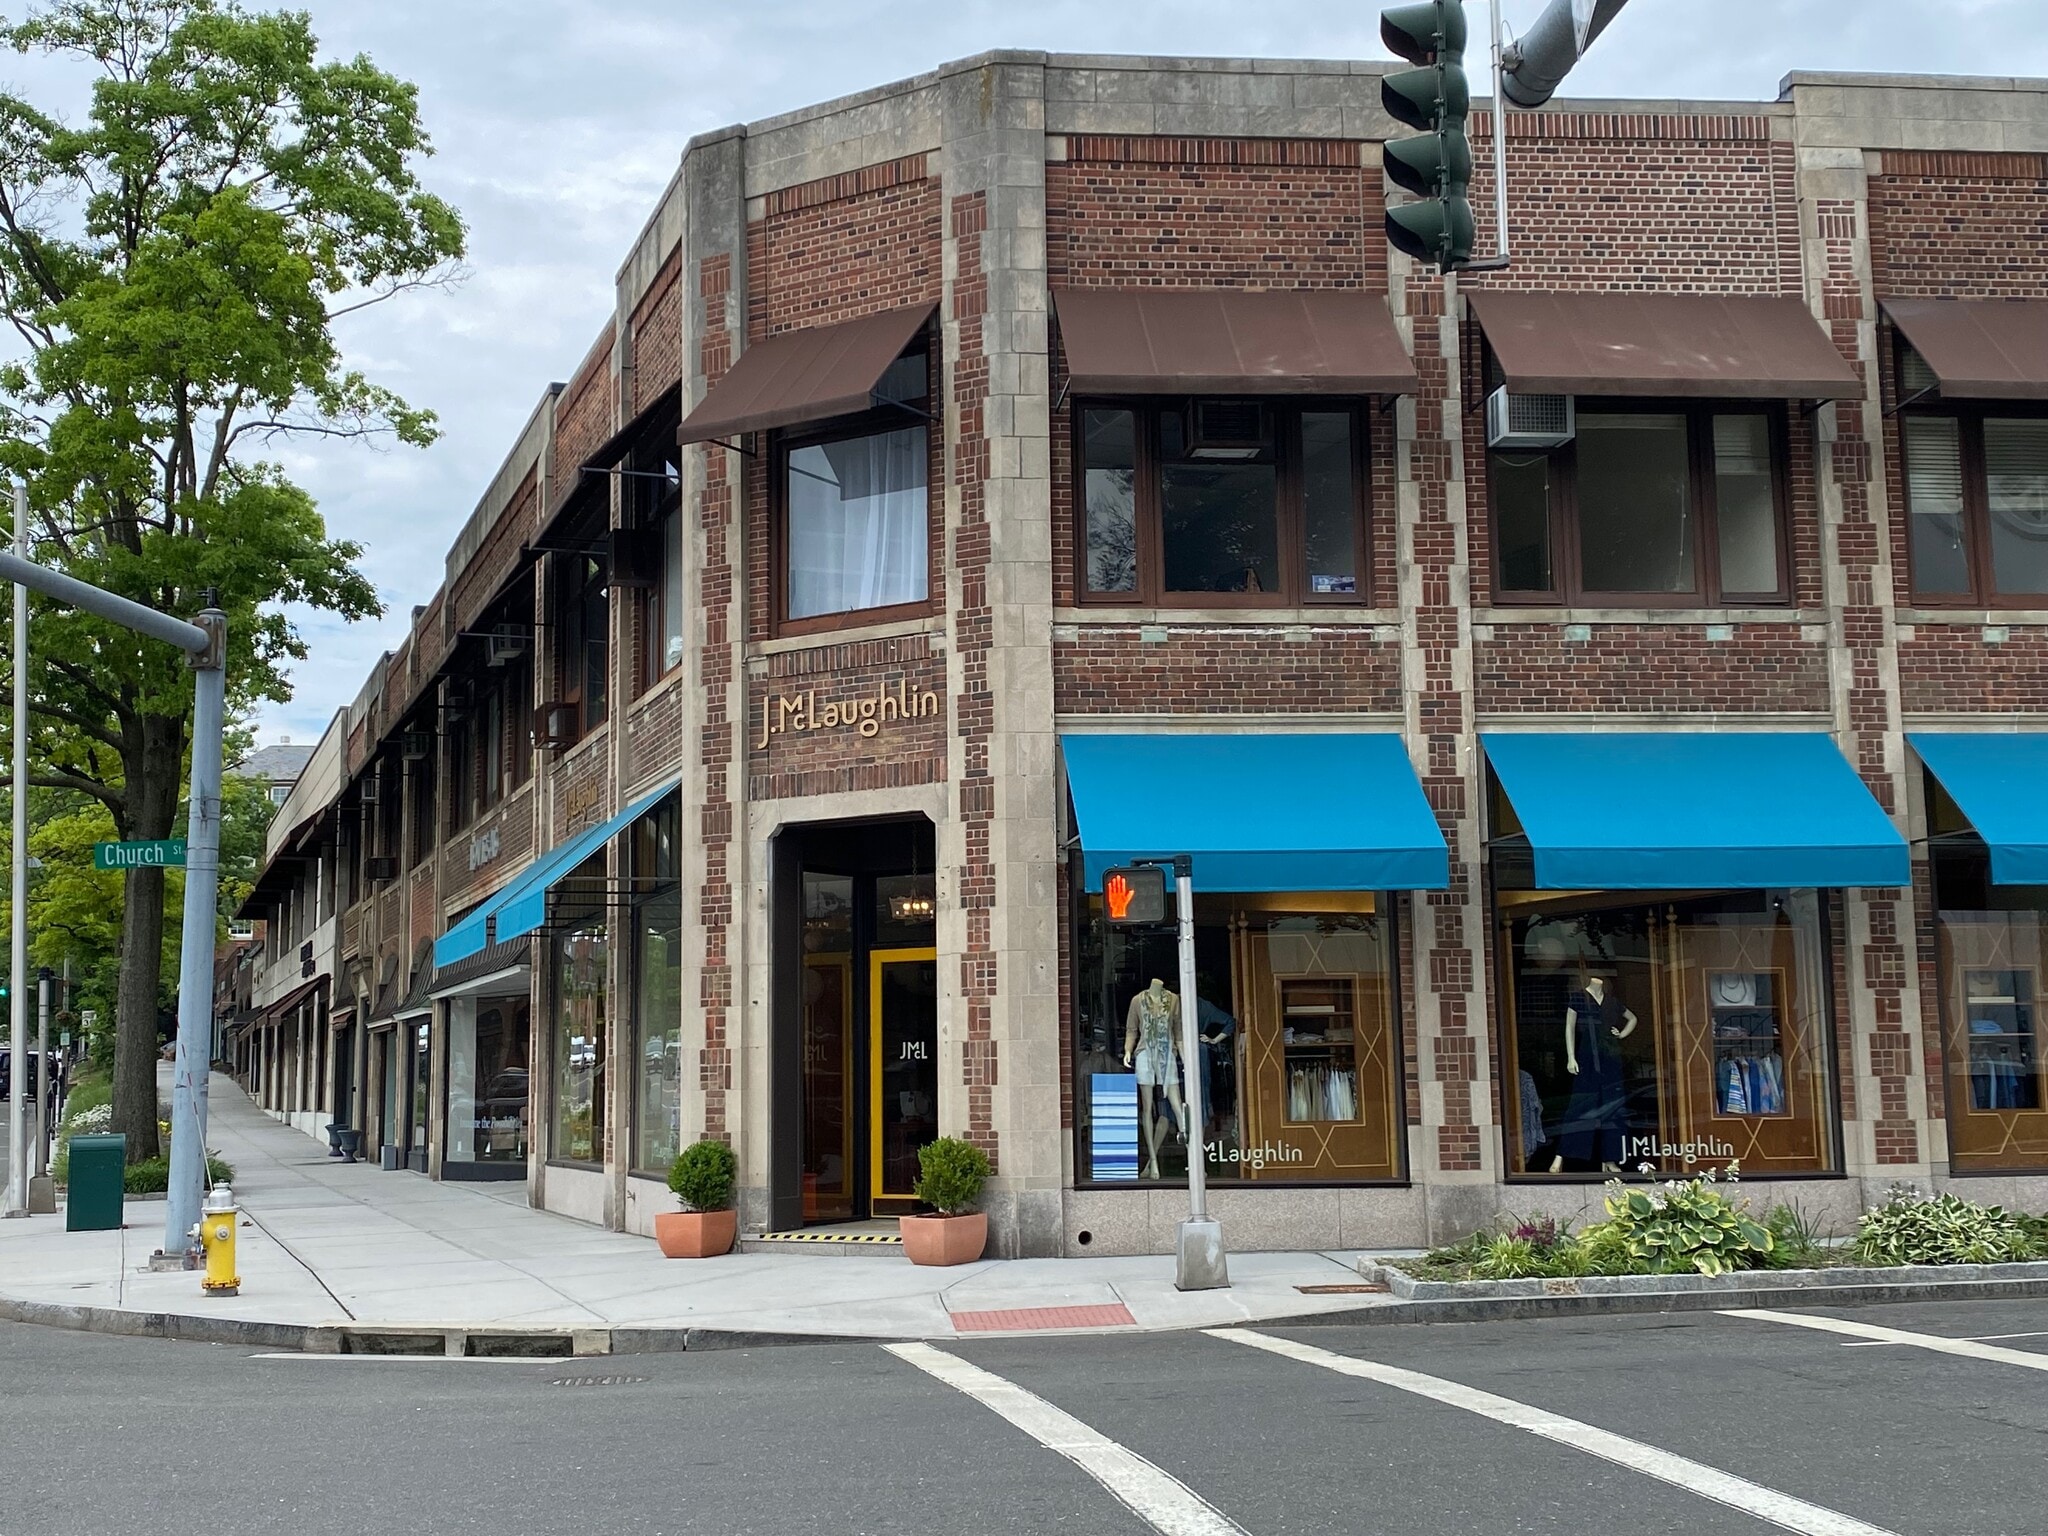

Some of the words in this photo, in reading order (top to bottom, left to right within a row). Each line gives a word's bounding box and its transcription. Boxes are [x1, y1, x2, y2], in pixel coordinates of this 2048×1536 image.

[757, 679, 939, 750] J.McLaughlin
[104, 843, 164, 865] Church
[1203, 1139, 1303, 1170] McLaughlin
[1618, 1134, 1734, 1165] J.McLaughlin
